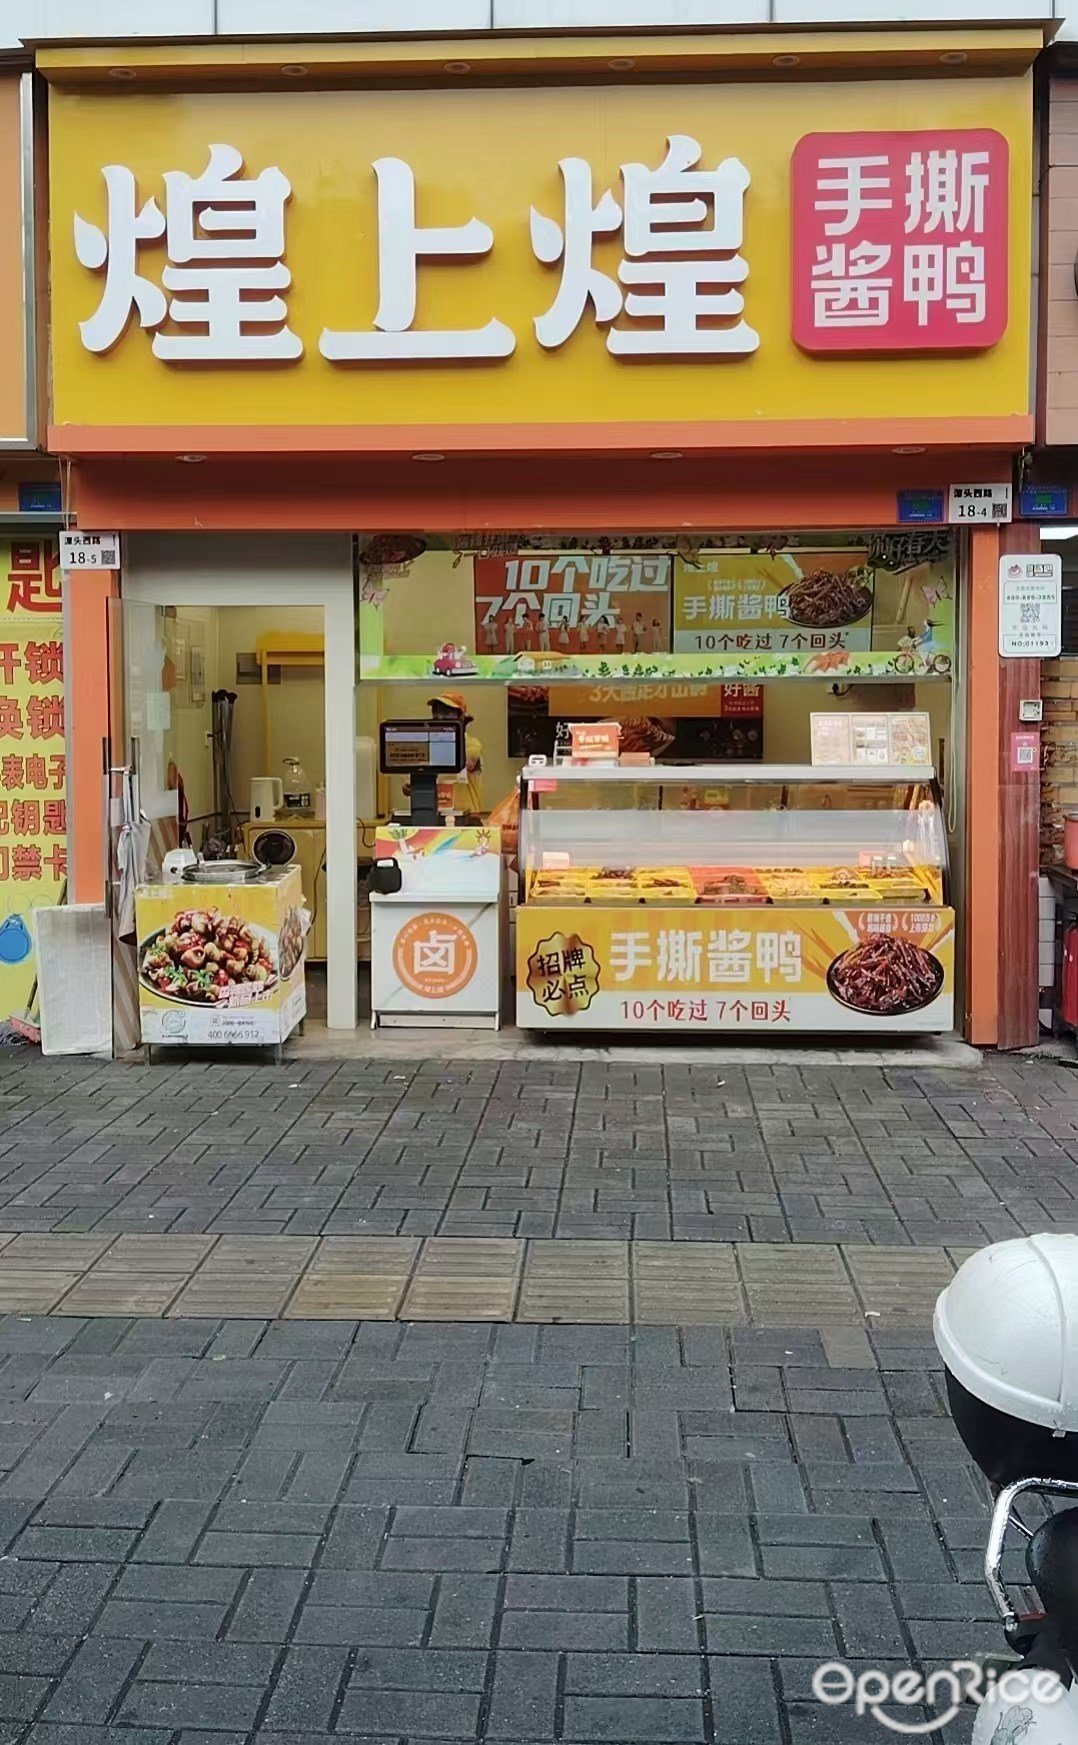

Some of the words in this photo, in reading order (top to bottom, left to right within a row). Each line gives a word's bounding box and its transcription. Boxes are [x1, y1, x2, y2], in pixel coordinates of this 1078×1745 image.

[815, 149, 990, 237] 手撕
[74, 135, 760, 362] 煌上煌
[812, 242, 987, 328] 酱鸭
[958, 504, 988, 517] 18-4
[69, 551, 97, 564] 18-5
[505, 556, 671, 593] 10个吃过
[475, 592, 621, 630] 7个回头
[682, 594, 790, 620] 手撕酱鸭
[694, 634, 771, 650] 10个吃过
[413, 929, 458, 975] 卤
[537, 947, 586, 977] 招牌
[609, 929, 802, 984] 手撕酱鸭
[543, 975, 590, 1003] 必点
[620, 1001, 708, 1022] 10个吃过
[717, 1001, 792, 1023] 7个回头
